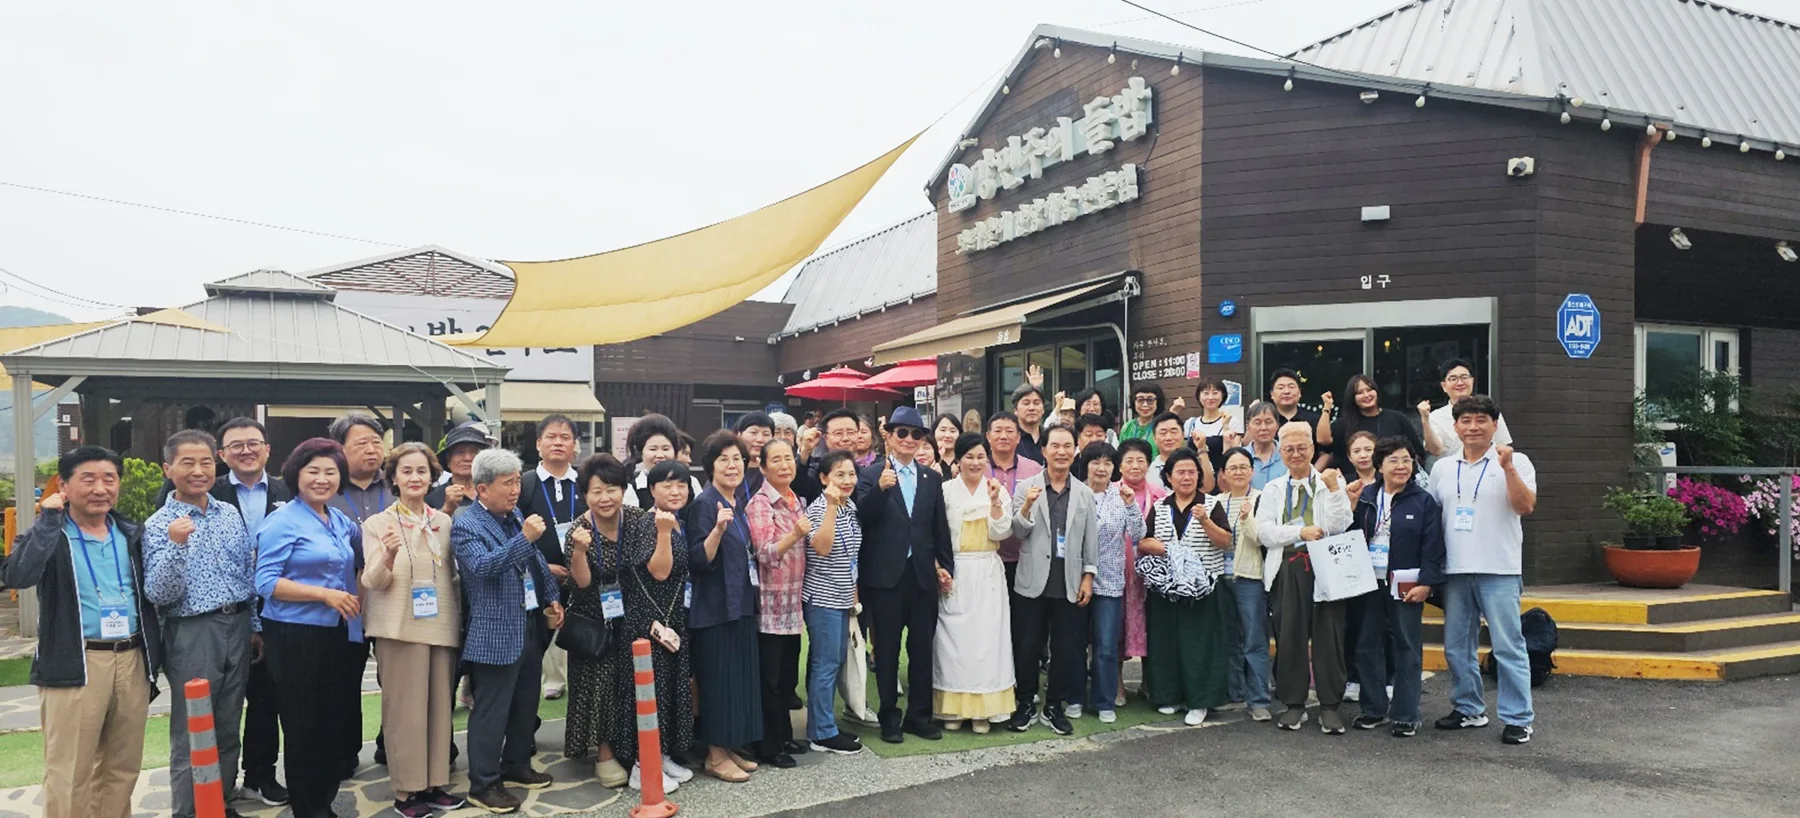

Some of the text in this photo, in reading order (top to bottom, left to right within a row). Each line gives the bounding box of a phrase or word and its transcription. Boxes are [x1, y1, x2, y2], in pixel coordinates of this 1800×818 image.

[1080, 76, 1153, 156] 들밥
[1078, 163, 1139, 214] 전문점
[1360, 274, 1392, 289] 입구
[1565, 314, 1594, 337] ADT
[1132, 359, 1157, 371] OPEN
[1163, 355, 1186, 367] 11:00
[1132, 369, 1157, 381] CLOSE
[1163, 365, 1186, 378] 20:00
